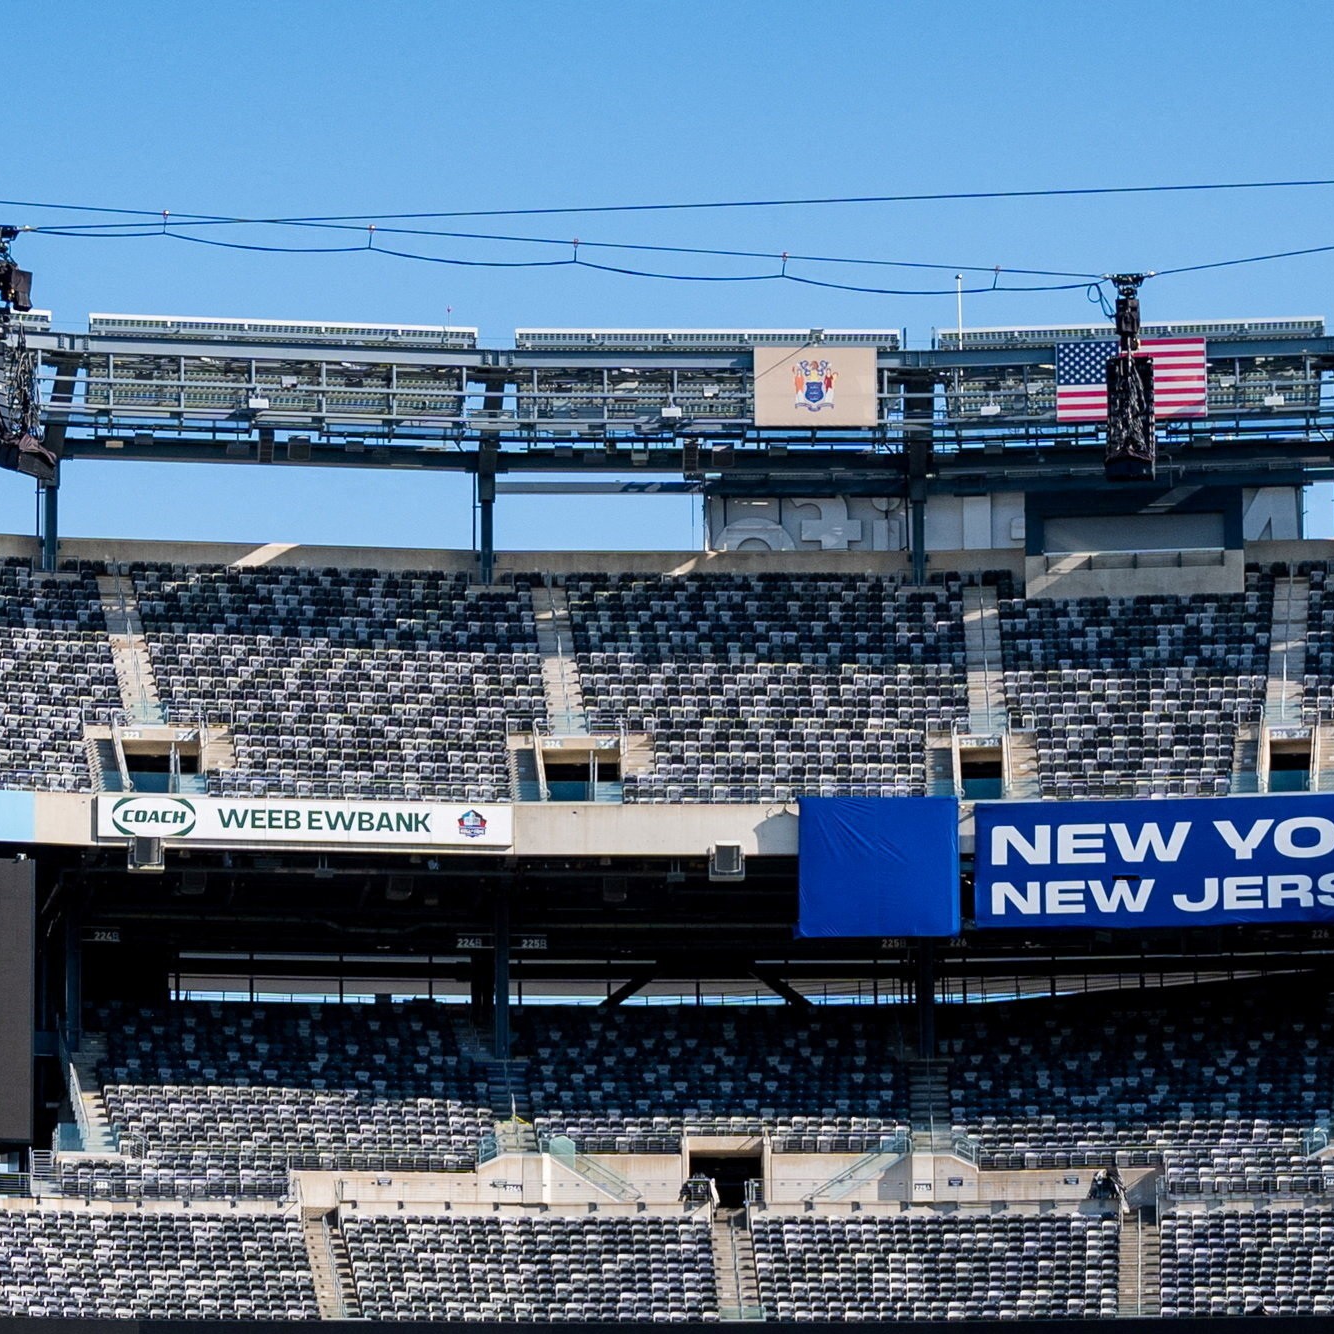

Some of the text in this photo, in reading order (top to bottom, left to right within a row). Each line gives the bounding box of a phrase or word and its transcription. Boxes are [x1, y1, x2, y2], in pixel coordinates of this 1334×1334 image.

[122, 810, 186, 824] COACH
[217, 808, 301, 831] WEEB
[307, 810, 432, 834] EWBANK
[991, 816, 1190, 865] NEW
[991, 877, 1157, 915] NEW
